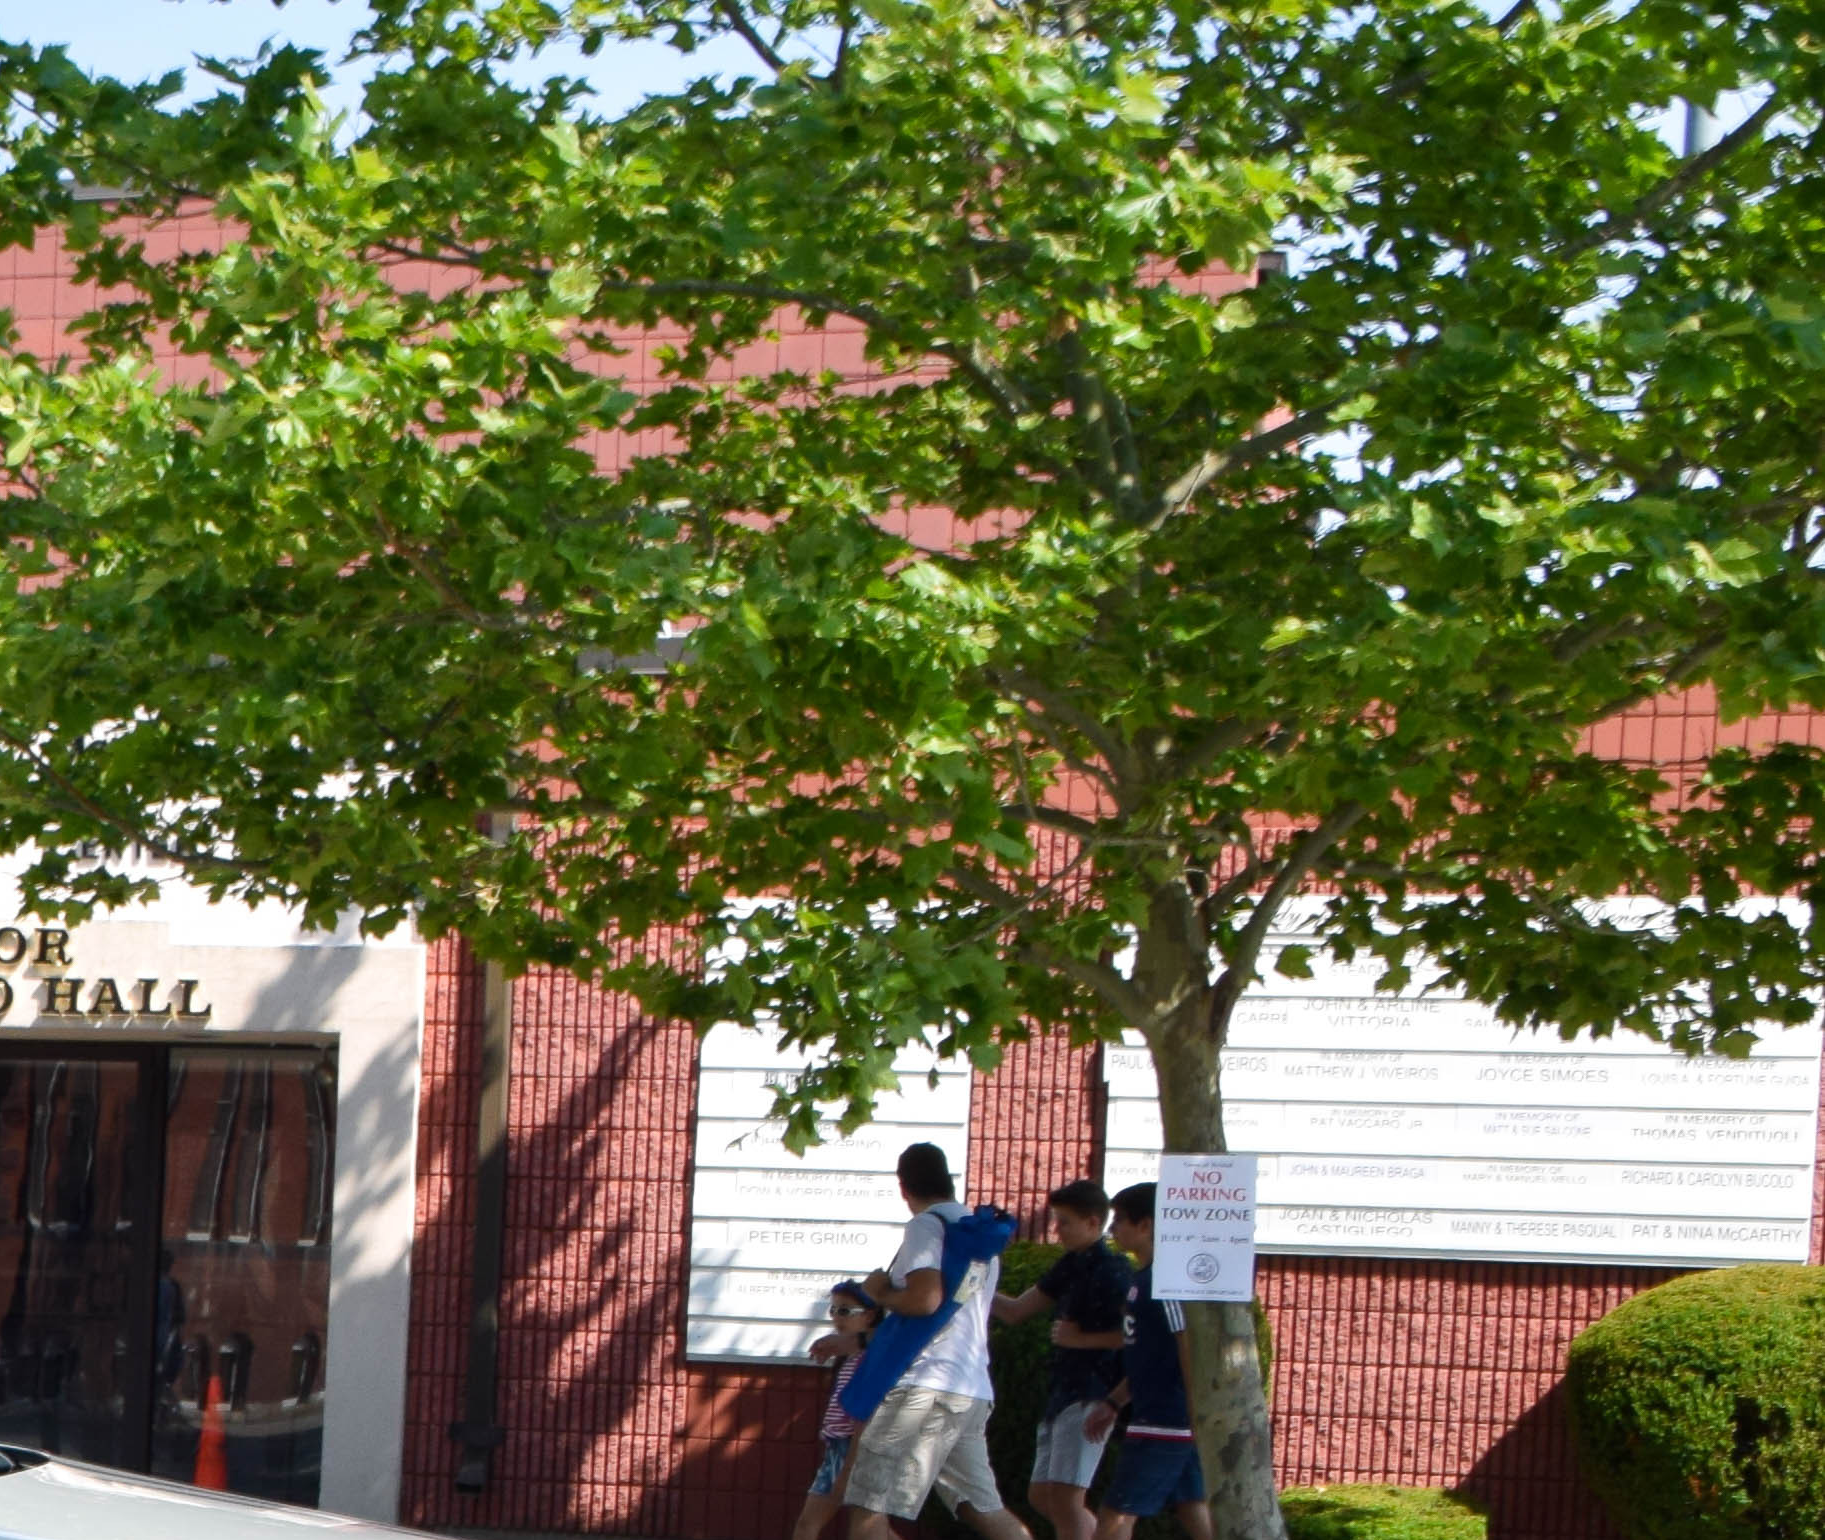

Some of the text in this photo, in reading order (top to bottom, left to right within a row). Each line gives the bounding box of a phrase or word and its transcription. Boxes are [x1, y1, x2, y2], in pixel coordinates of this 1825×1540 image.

[40, 978, 213, 1018] HALL
[1303, 1000, 1441, 1014] JOHN & ARLINE
[1328, 1015, 1411, 1029] VITTORIA
[1111, 1053, 1144, 1071] PAUL
[1283, 1064, 1354, 1079] MATTHEW
[1372, 1066, 1439, 1081] VIVEIROS
[1475, 1067, 1610, 1084] JOYCE SIMOES
[1340, 1108, 1388, 1118] MEMORY
[1509, 1112, 1562, 1122] MEMORY
[1565, 1113, 1581, 1122] OF
[1665, 1114, 1767, 1125] IN MEMORY OF
[1310, 1118, 1334, 1128] PAT
[1338, 1118, 1401, 1129] VACCARO
[1631, 1127, 1696, 1140] THOMAS
[1289, 1163, 1426, 1180] JOHN & MAUREEN BRAGA
[1499, 1165, 1546, 1174] MEMORY
[1193, 1171, 1222, 1185] NO
[1621, 1170, 1795, 1190] RICHARD & CAROLYN BUCOLO
[1167, 1187, 1247, 1202] PARKING
[1161, 1207, 1251, 1221] TOW ZONE
[1278, 1208, 1434, 1225] JOAN & NICHOLAS
[1451, 1220, 1492, 1234] MANNY
[1495, 1221, 1502, 1235] &
[1506, 1222, 1558, 1237] THERESE
[1632, 1224, 1802, 1243] PAT & NINA McCARTHY
[749, 1230, 869, 1247] PETER GRIMO
